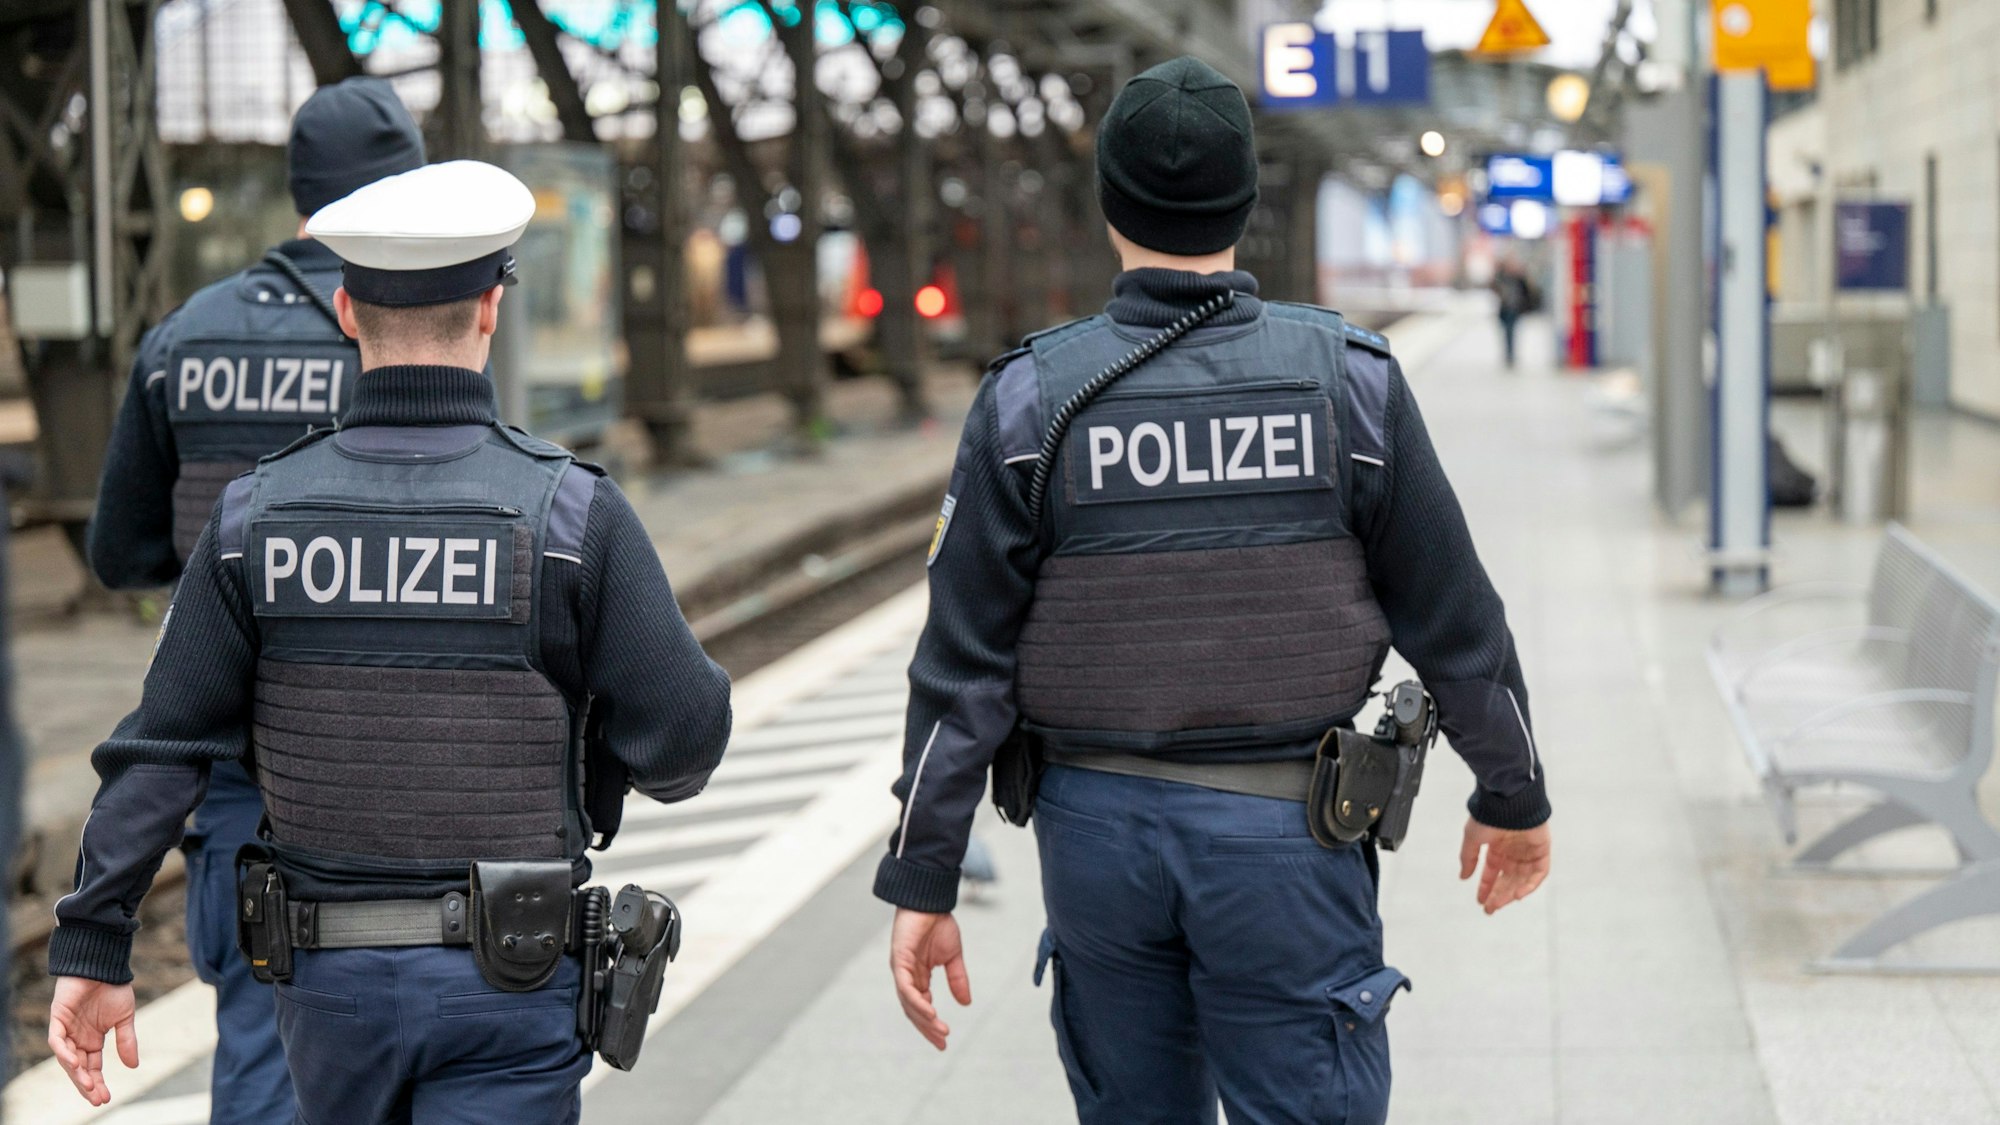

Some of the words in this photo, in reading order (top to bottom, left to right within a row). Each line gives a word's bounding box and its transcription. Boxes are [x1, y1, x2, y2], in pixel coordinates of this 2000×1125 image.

[1264, 22, 1317, 97] E
[178, 356, 345, 413] POLIZEI
[1088, 413, 1316, 490] POLIZEI
[264, 535, 498, 605] POLIZEI
